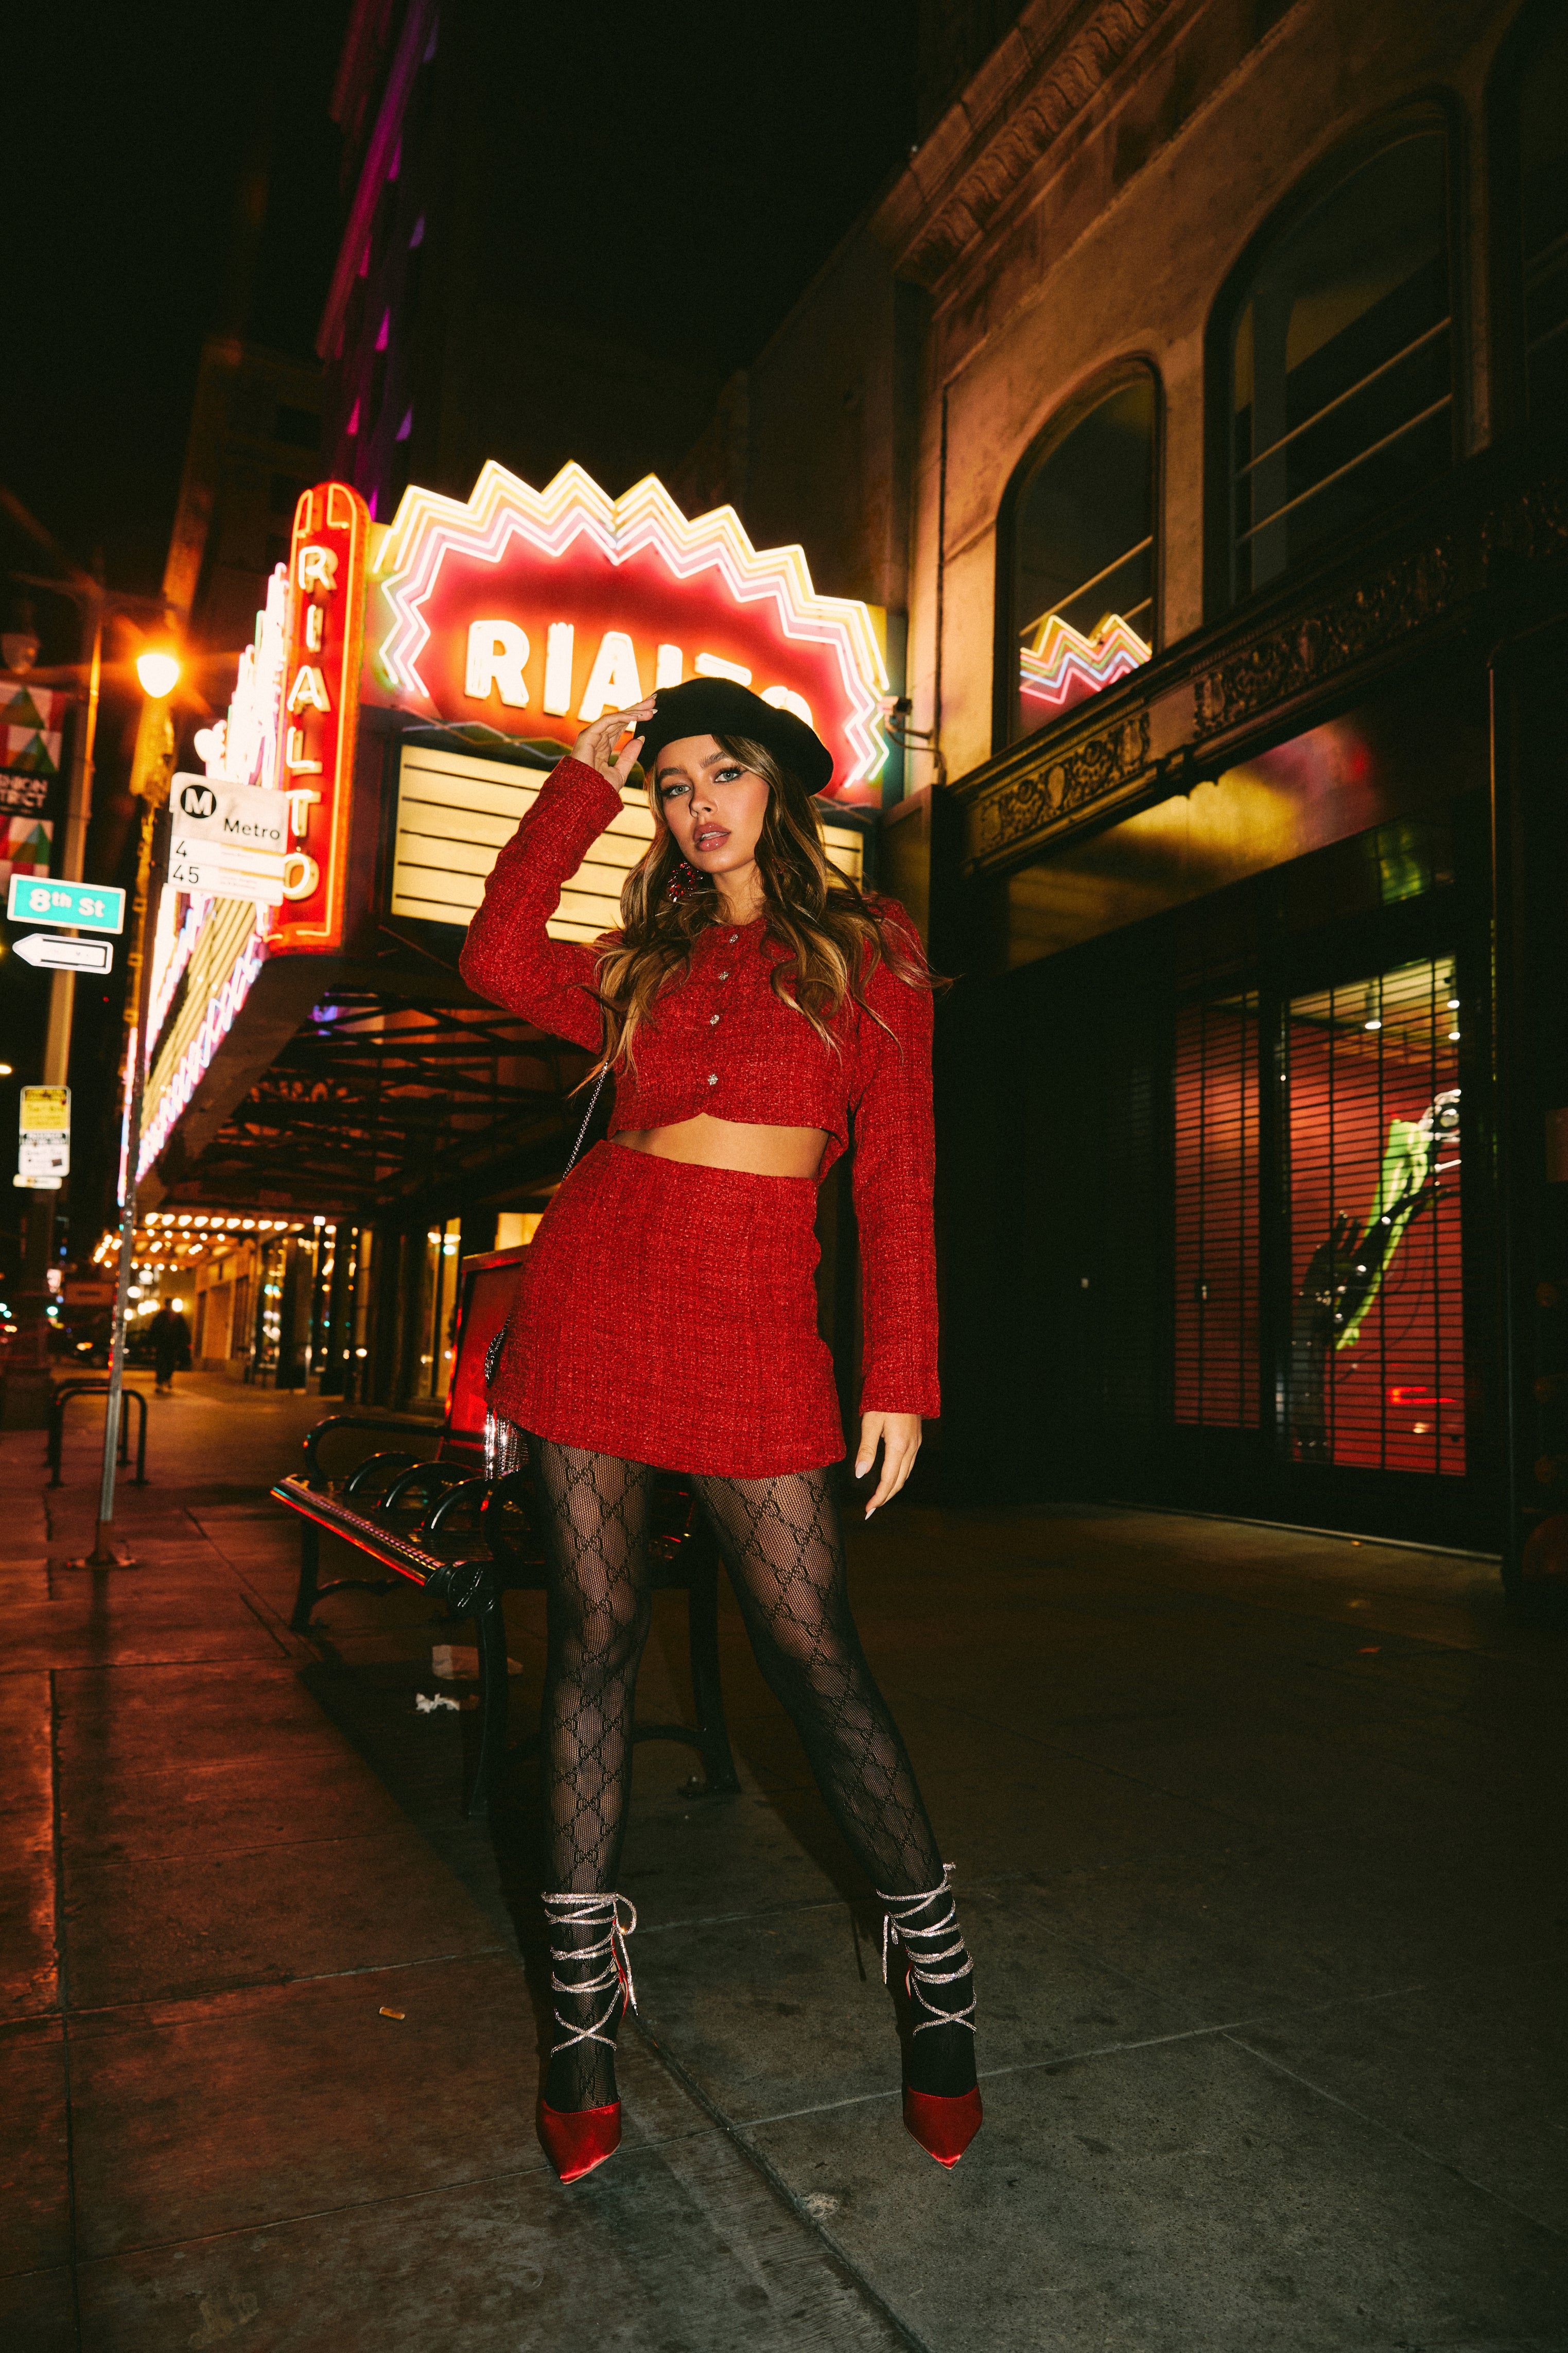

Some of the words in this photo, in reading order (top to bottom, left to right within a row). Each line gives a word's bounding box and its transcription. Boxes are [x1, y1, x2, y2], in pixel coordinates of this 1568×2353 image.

[282, 545, 338, 901] RIALTO
[183, 787, 214, 817] M
[223, 818, 281, 840] Metro
[176, 840, 187, 858] 4
[173, 864, 199, 884] 45
[29, 888, 73, 913] 8th
[78, 897, 106, 918] St
